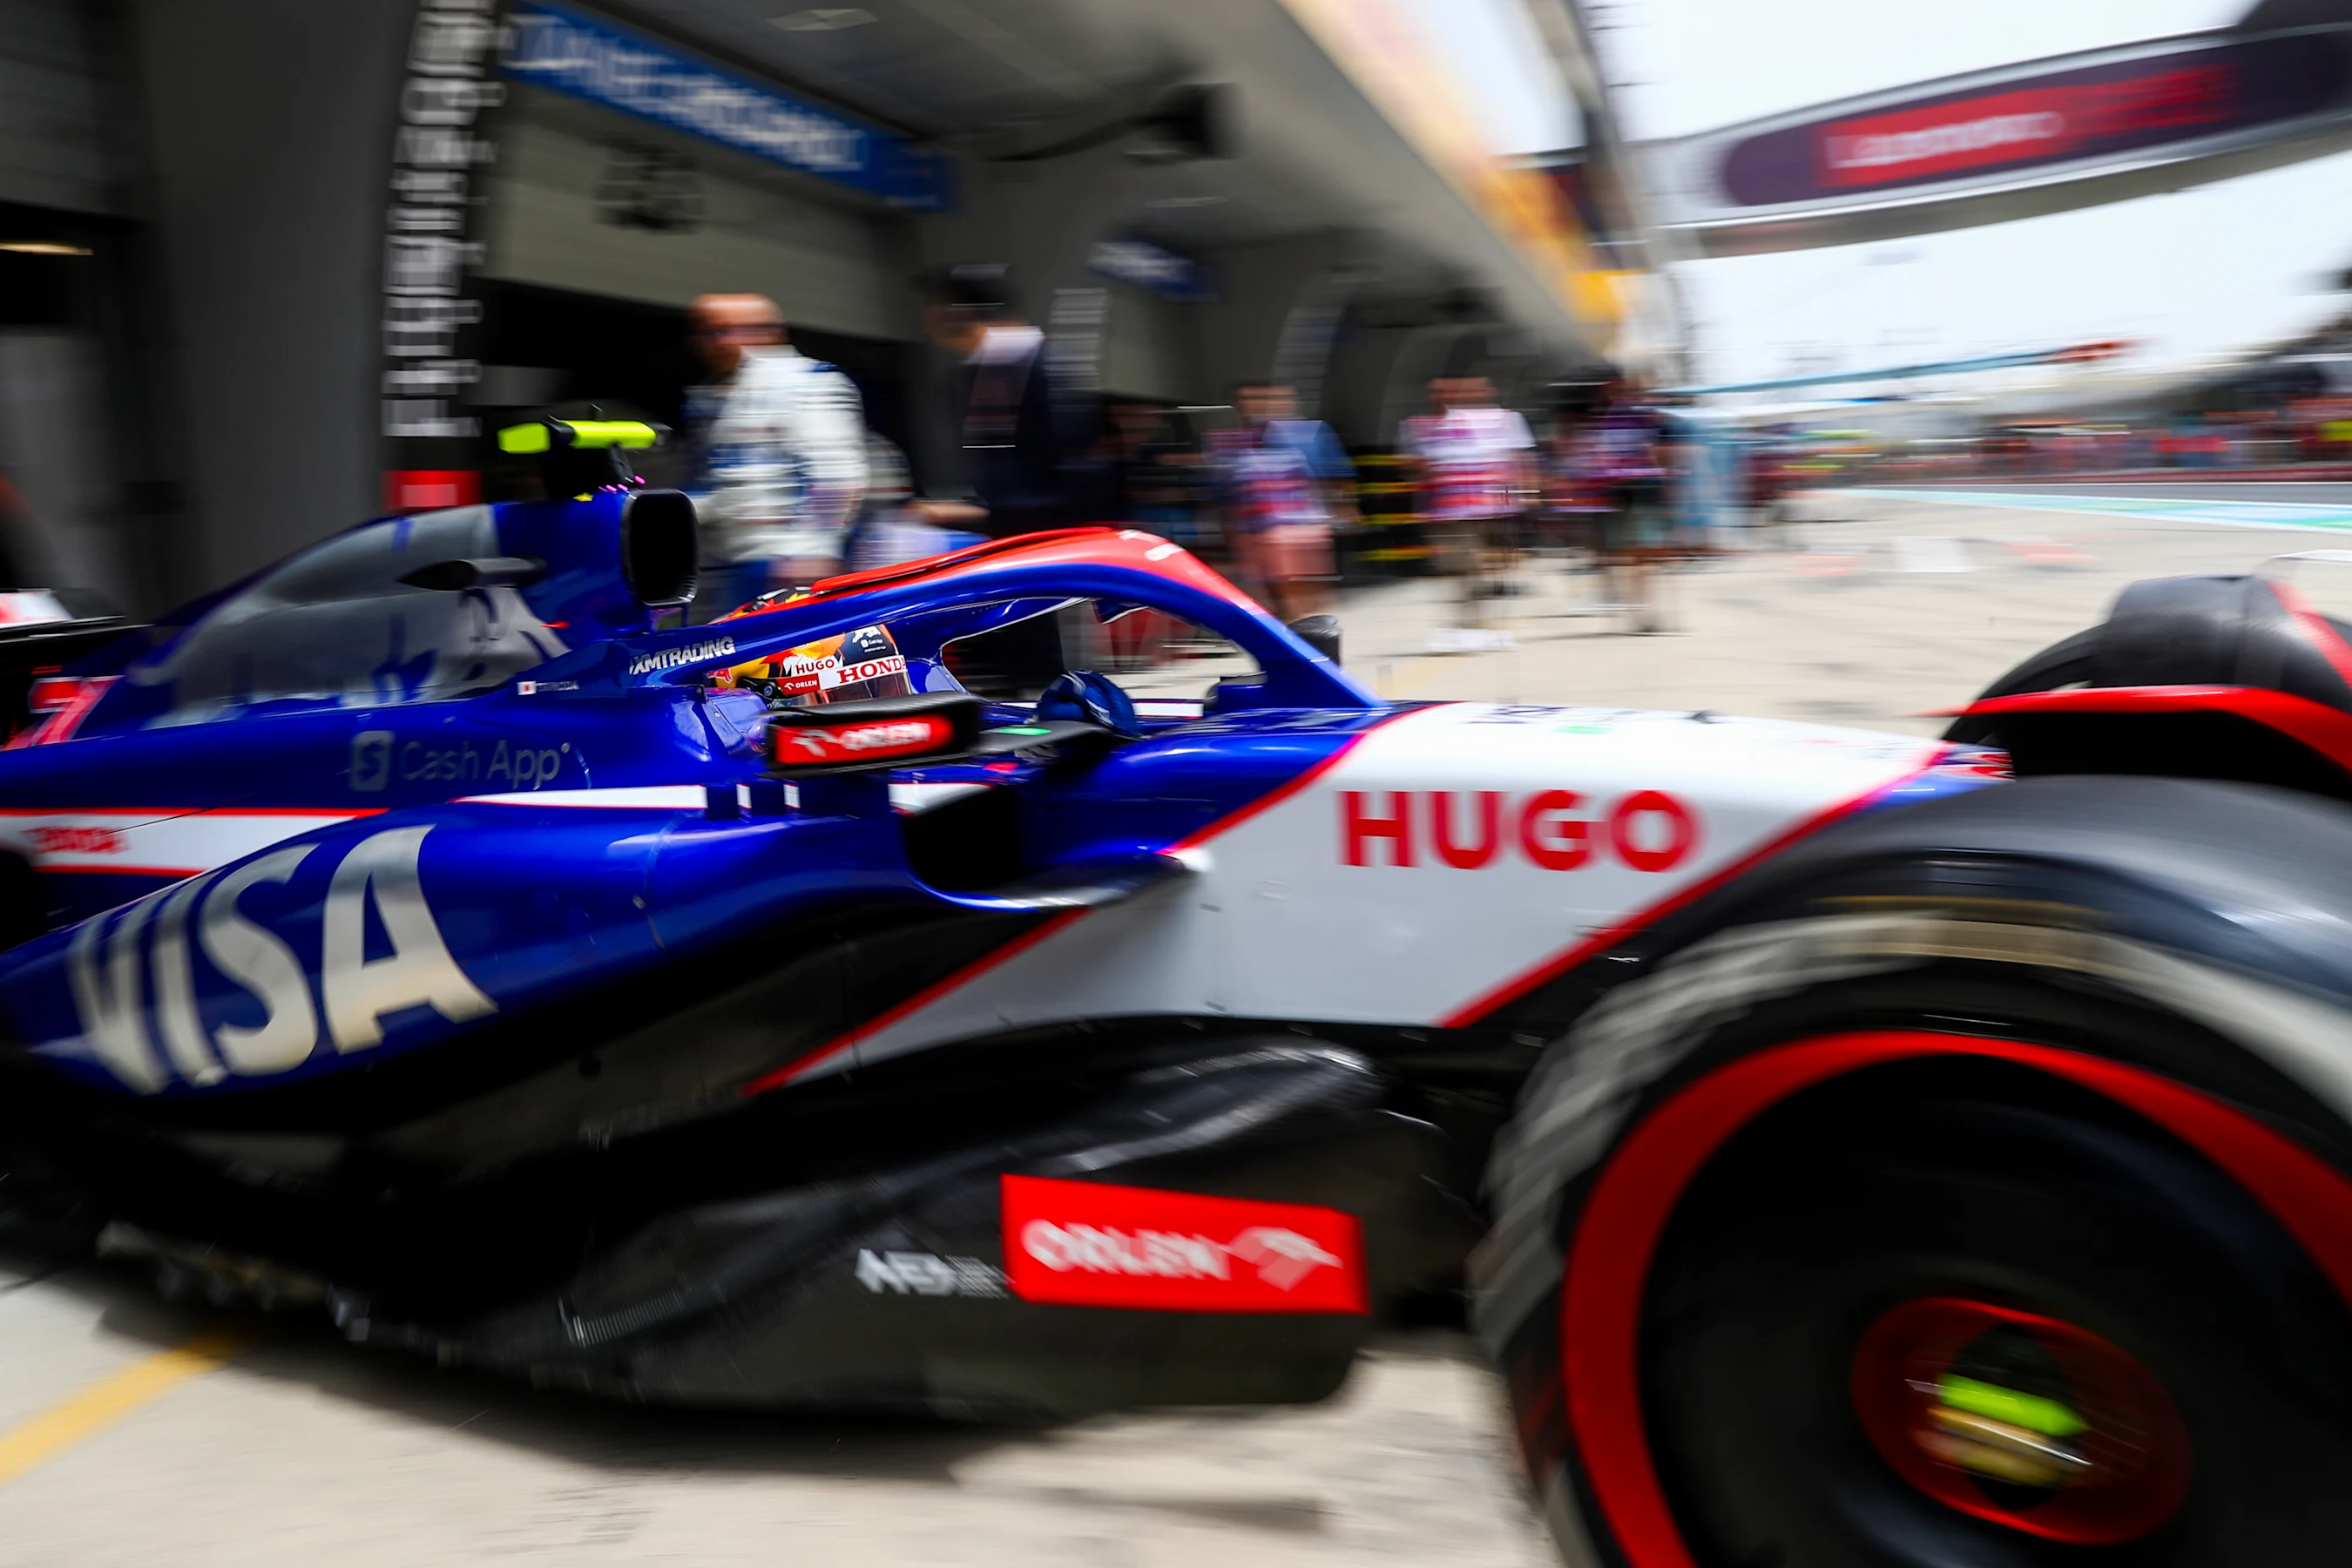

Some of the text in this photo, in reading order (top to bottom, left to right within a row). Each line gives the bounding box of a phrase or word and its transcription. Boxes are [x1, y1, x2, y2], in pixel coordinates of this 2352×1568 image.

[629, 636, 736, 674] XMTRADING
[795, 659, 835, 674] HUGO
[837, 655, 906, 684] HOND
[794, 679, 817, 689] ORLEN
[402, 740, 562, 790] Cash App
[1336, 788, 1705, 874] HUGO
[67, 823, 499, 1096] VISA
[1021, 1220, 1231, 1281] ORLEN
